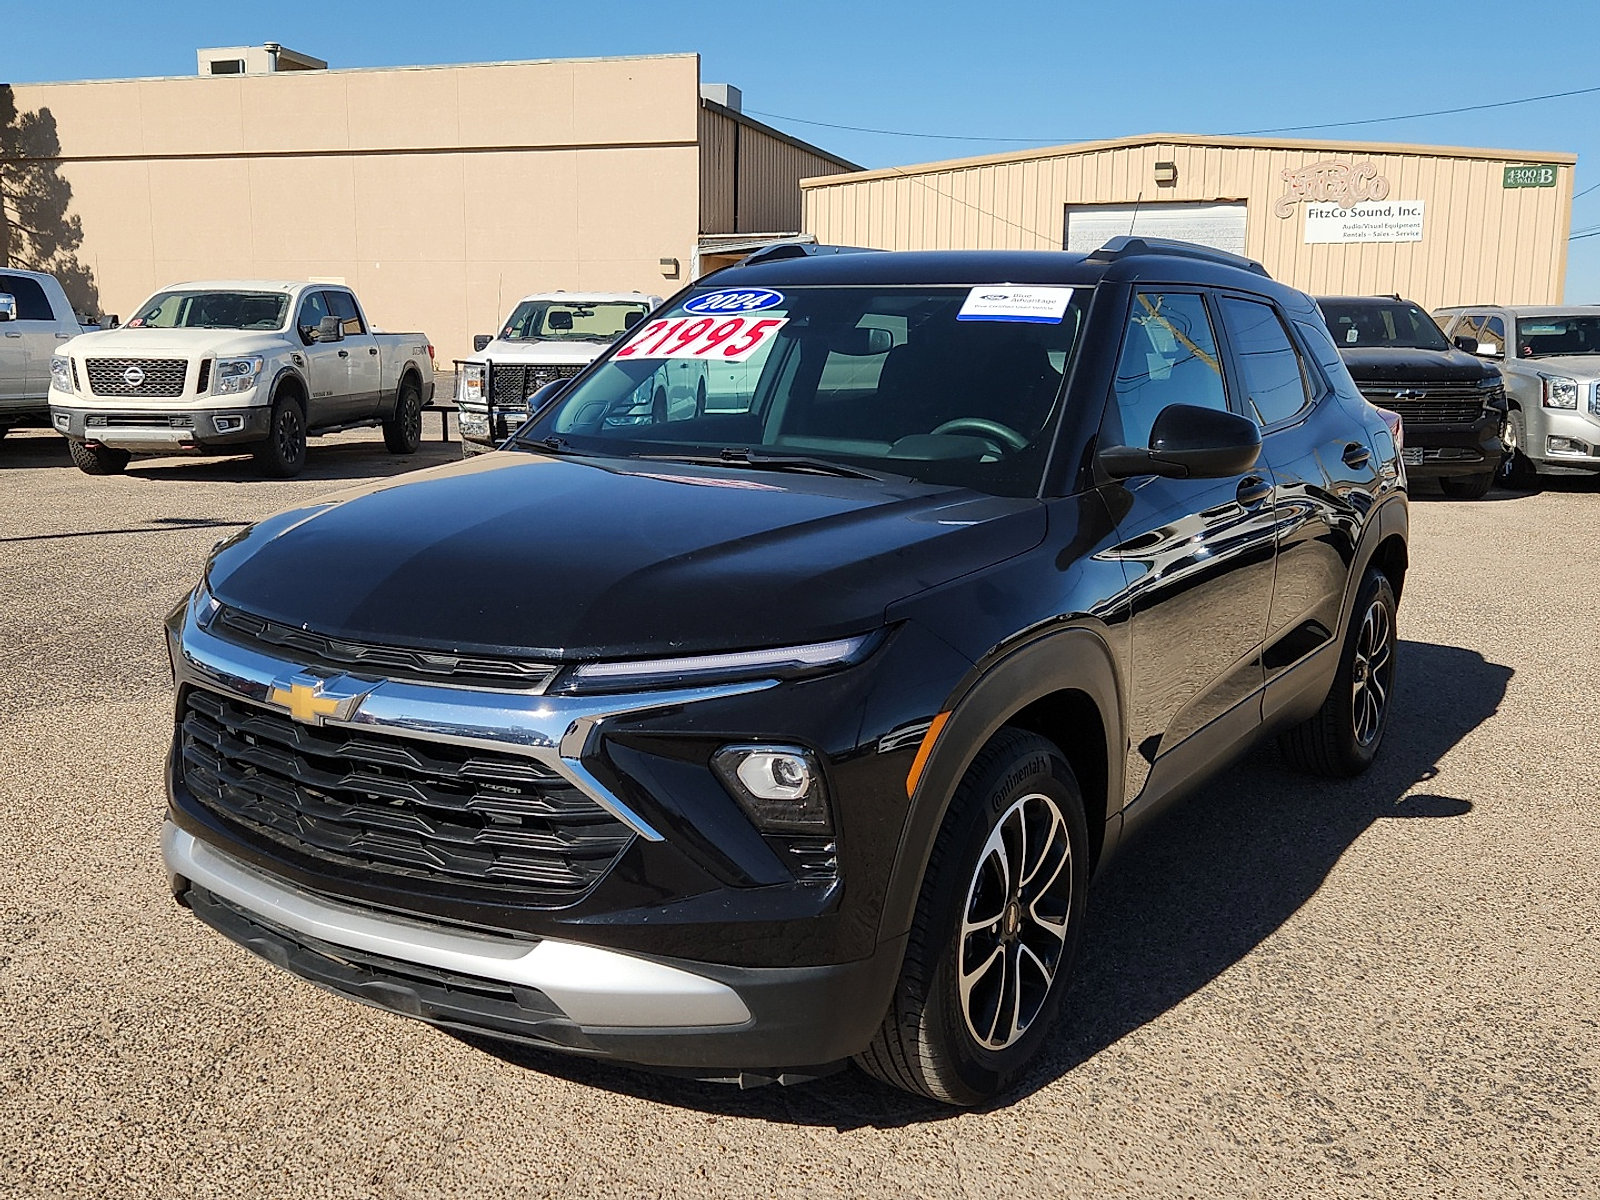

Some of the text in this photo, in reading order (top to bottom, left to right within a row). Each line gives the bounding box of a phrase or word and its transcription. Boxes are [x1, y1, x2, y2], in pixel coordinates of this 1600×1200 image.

[1507, 168, 1537, 179] 4300
[1539, 168, 1553, 184] B
[1308, 206, 1421, 219] FitzCo Sound, Inc.
[1384, 222, 1421, 230] Equipment
[692, 292, 775, 311] 2024
[616, 317, 783, 358] 21995
[992, 755, 1040, 814] Continental
